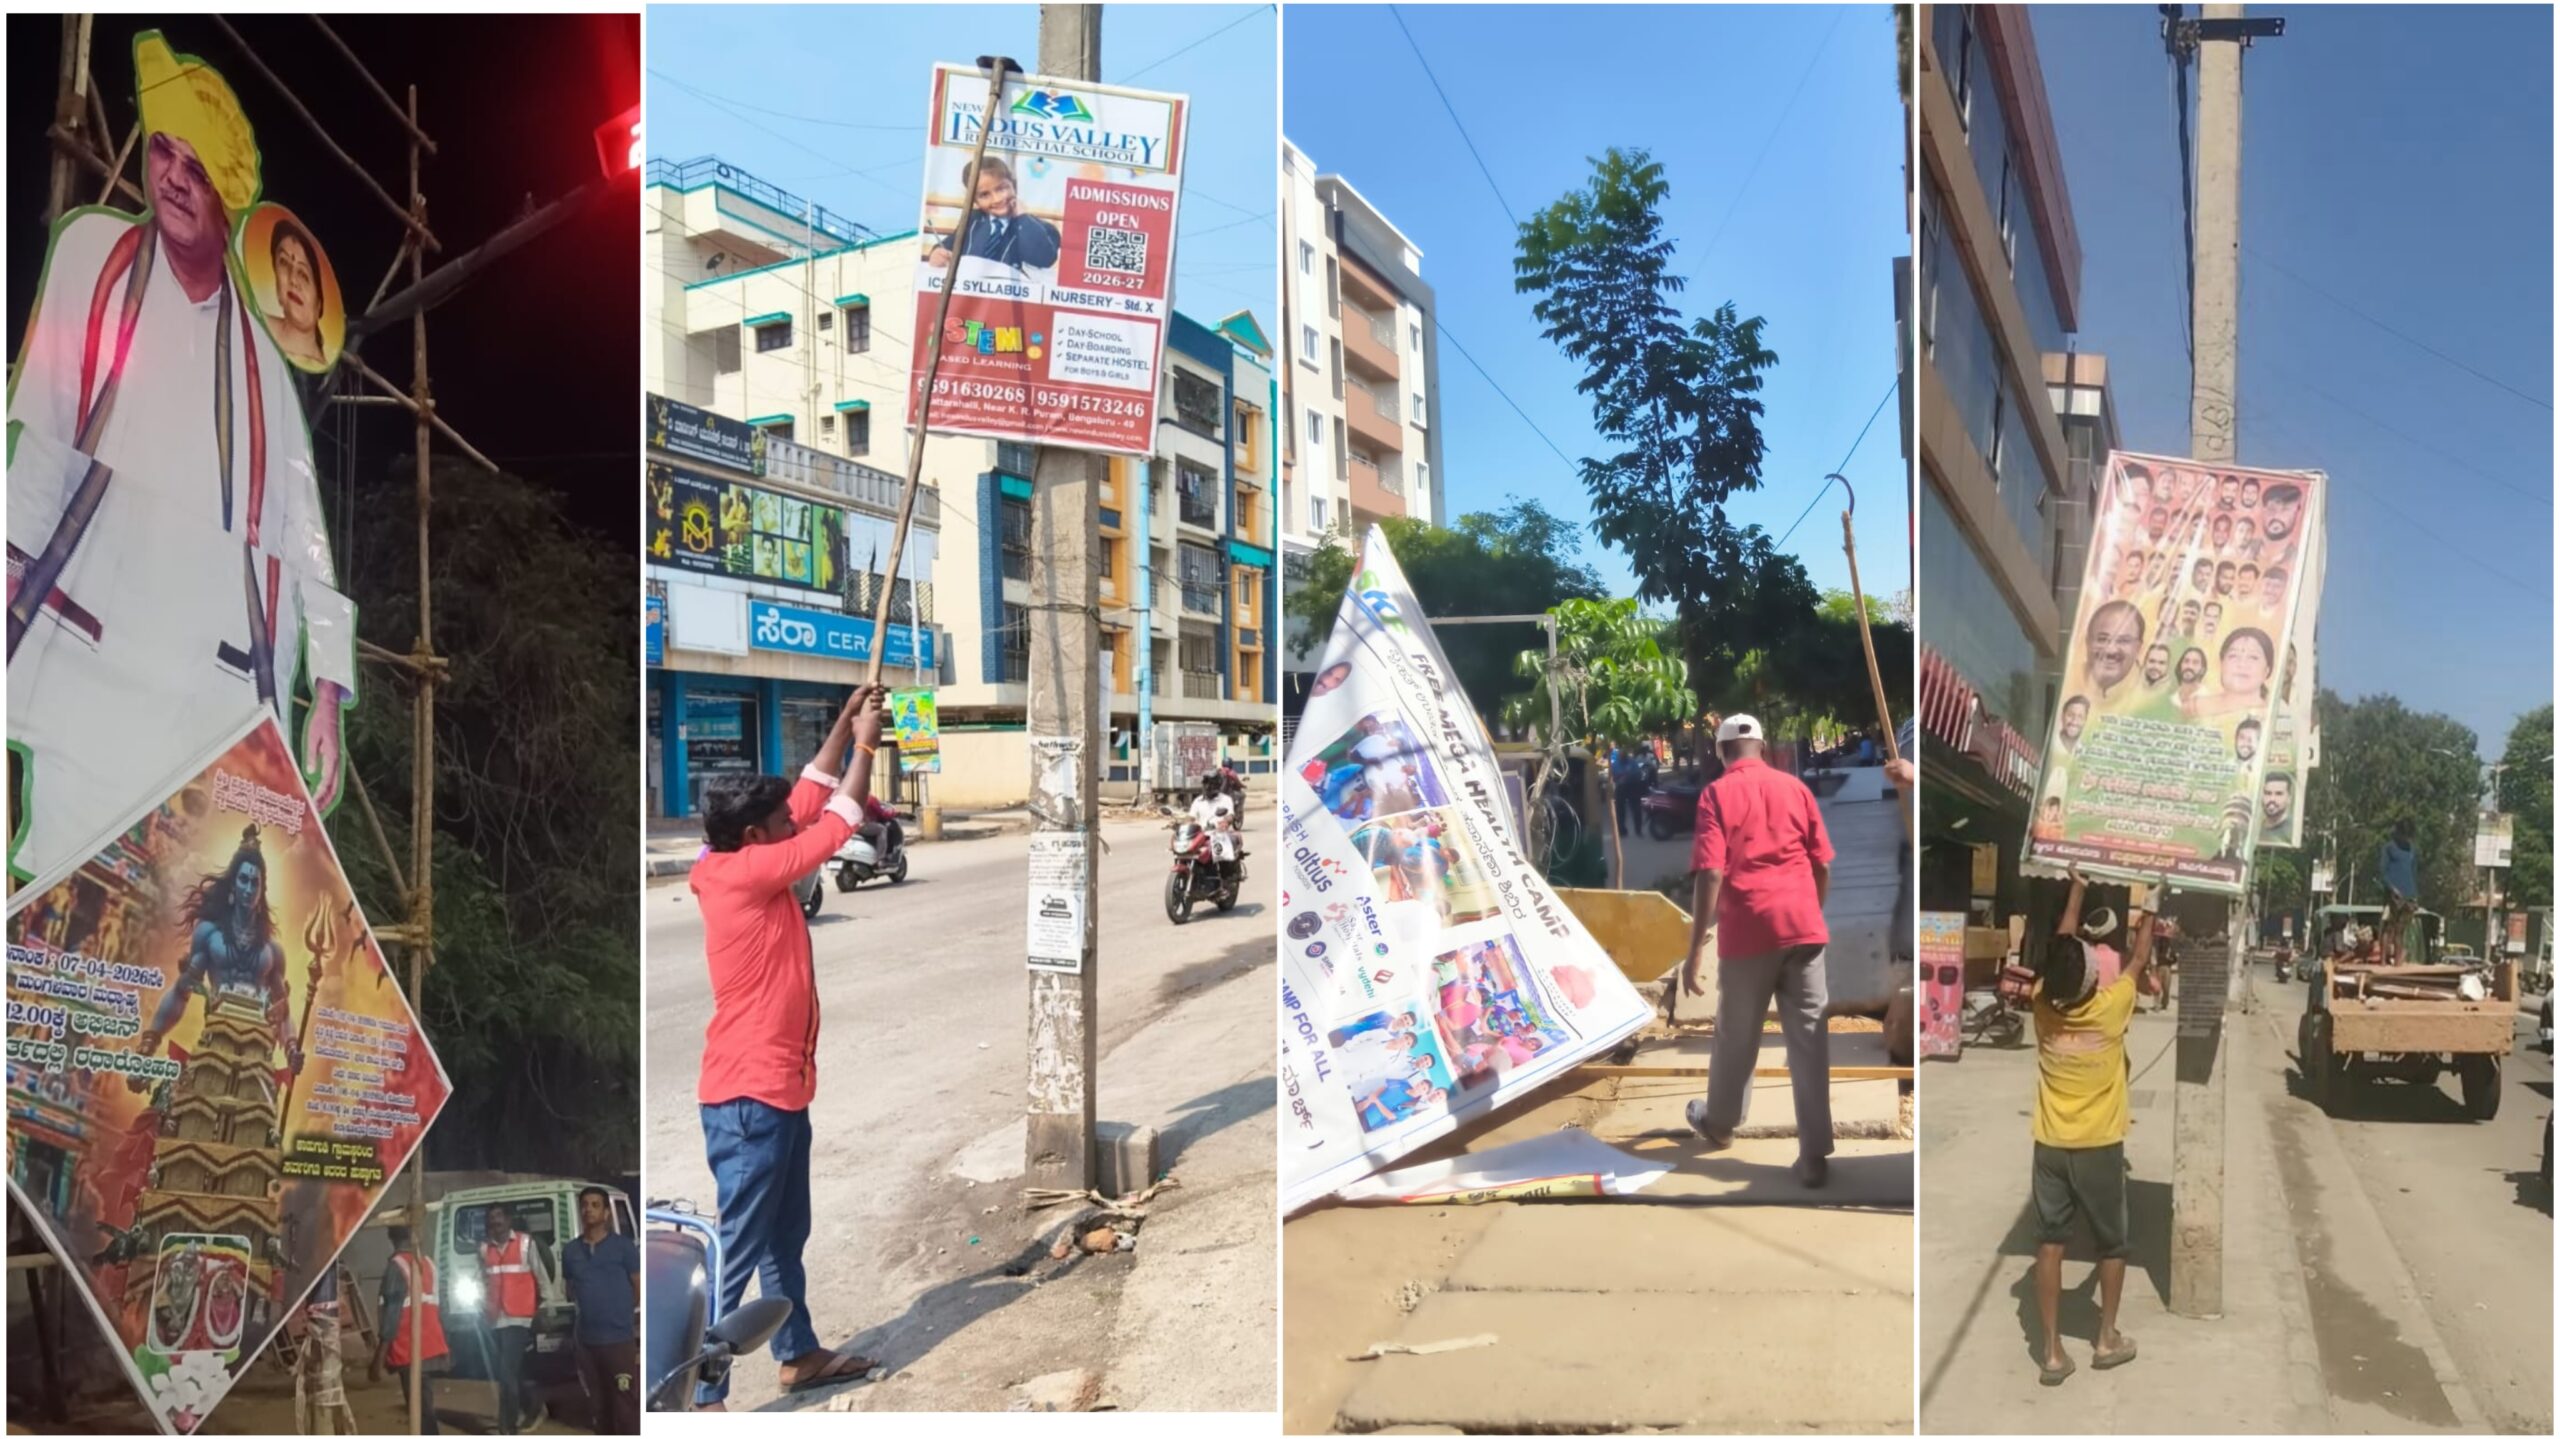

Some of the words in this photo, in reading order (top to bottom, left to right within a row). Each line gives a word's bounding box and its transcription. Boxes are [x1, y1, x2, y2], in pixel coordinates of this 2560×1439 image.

[952, 101, 983, 112] NEW
[950, 112, 1043, 141] INDUS
[1050, 125, 1161, 165] VALLEY
[1072, 145, 1138, 164] SCHOOL
[1069, 185, 1169, 211] ADMISSIONS
[1096, 211, 1139, 228] OPEN
[963, 280, 1030, 298] SYLLABUS
[1083, 272, 1145, 290] 2026-27
[1051, 290, 1113, 308] NURSERY
[1124, 299, 1142, 312] Std.
[1145, 302, 1154, 313] X
[939, 354, 970, 365] ASED
[973, 356, 1032, 371] LEARNING
[1066, 351, 1110, 366] SEPARATE
[1111, 356, 1150, 370] HOSTEL
[983, 402, 1006, 413] Near
[1037, 393, 1145, 418] 9591573246
[757, 607, 816, 647] ಸೆರಾ
[1411, 652, 1444, 702] FREE
[1438, 710, 1476, 775] MEGA
[1463, 780, 1526, 867] HEALTH
[1521, 873, 1571, 939] CAMP
[1294, 846, 1333, 893] altius
[1355, 896, 1382, 937] Aster
[6, 944, 45, 966] ನಾಂಕ
[1283, 978, 1302, 1011] AMP
[1293, 1011, 1319, 1046] FOR
[1312, 1049, 1332, 1083] ALL
[75, 1048, 180, 1078] ರಥಾರೋಹಣ
